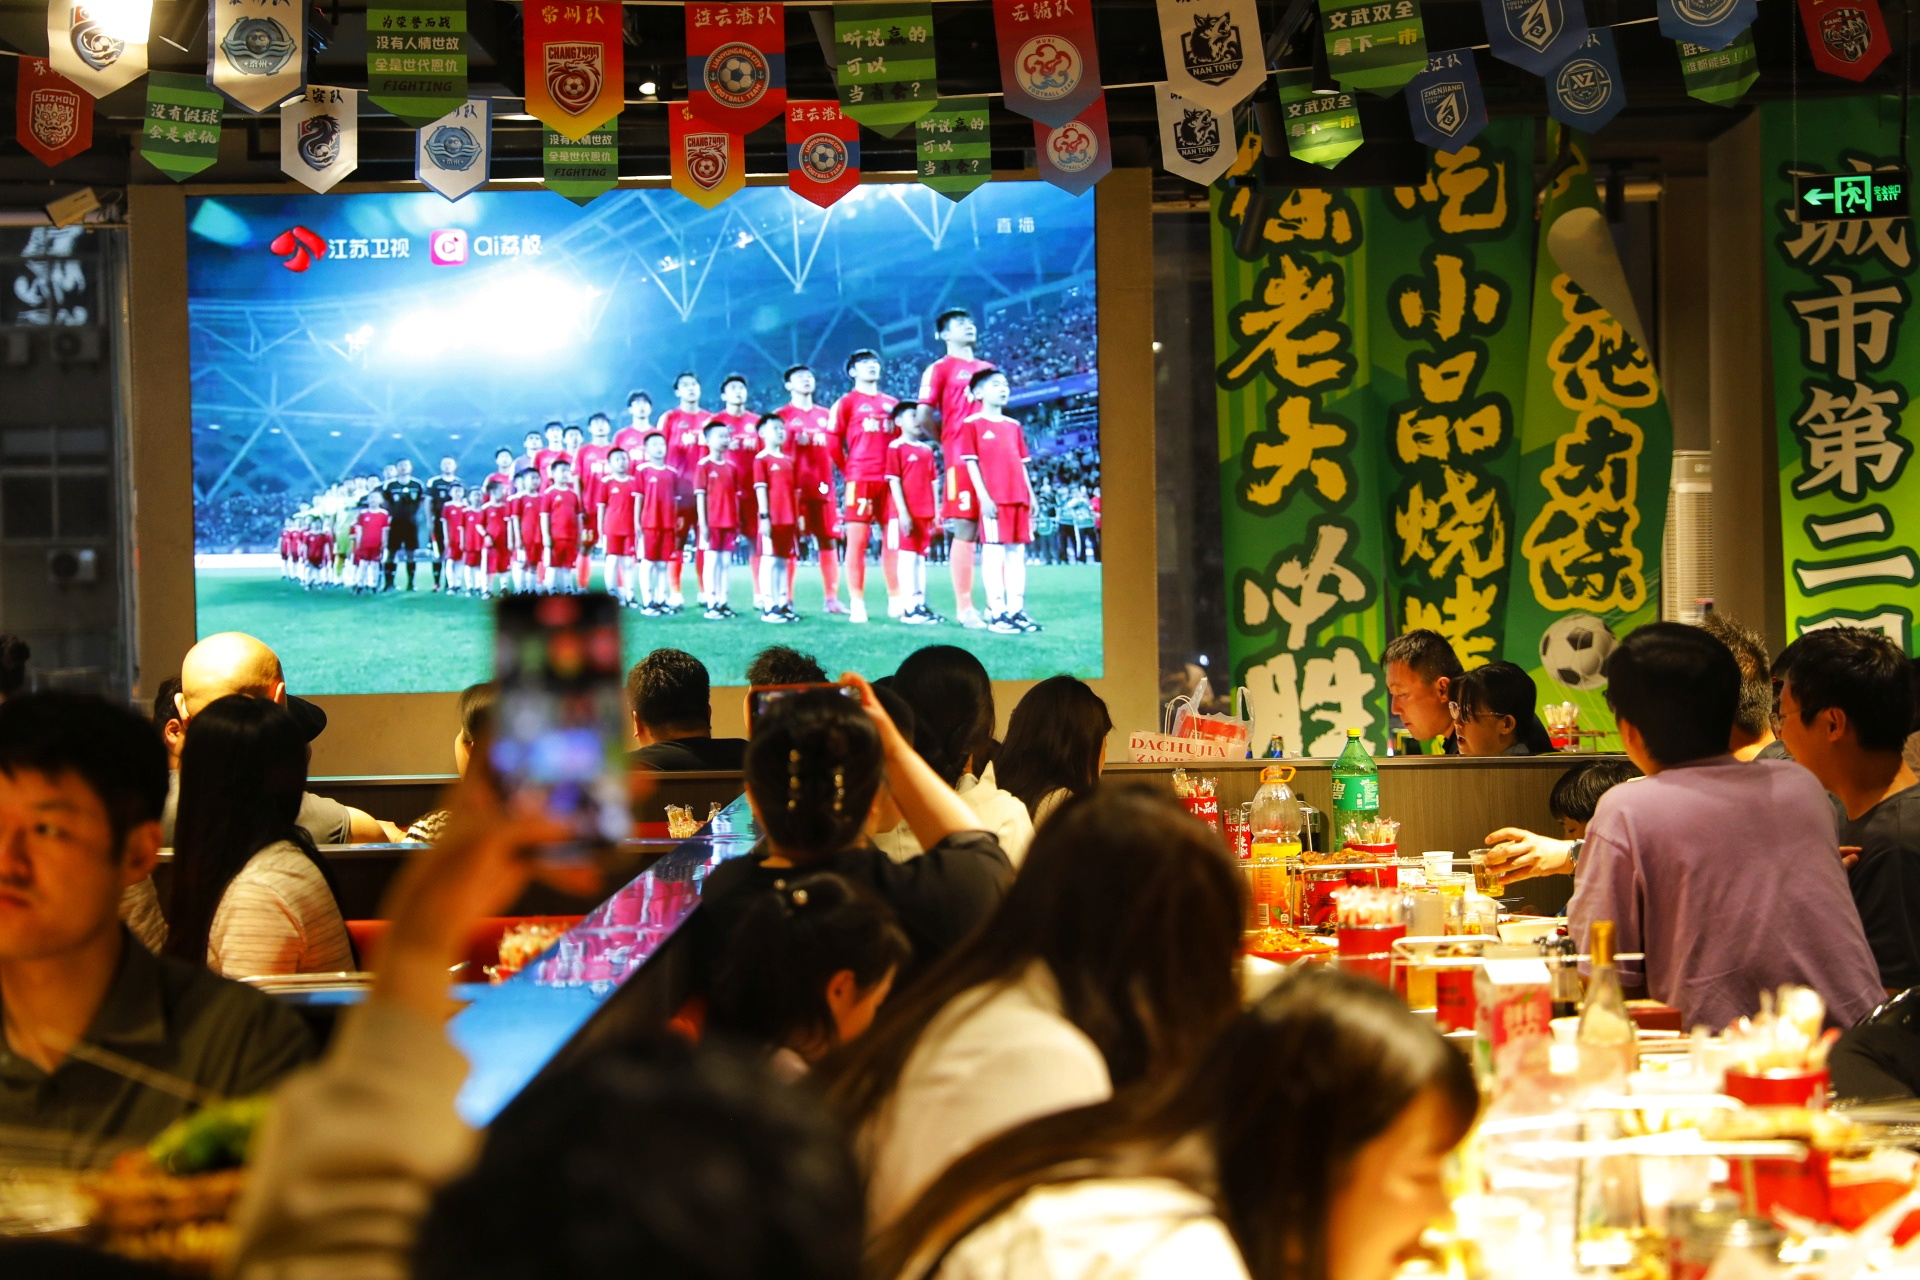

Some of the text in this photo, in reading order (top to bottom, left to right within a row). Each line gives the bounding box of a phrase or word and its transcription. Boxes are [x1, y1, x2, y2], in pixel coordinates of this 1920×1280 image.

[542, 5, 604, 25] 常州队
[694, 6, 776, 28] 连云港队
[1012, 0, 1074, 21] 无锡队
[1329, 0, 1414, 30] 文武双全
[383, 15, 451, 29] 为荣誉而战
[376, 35, 460, 51] 没有人情世故
[1333, 28, 1417, 56] 拿下一市
[374, 58, 458, 72] 全是世代恩仇
[750, 54, 763, 68] CITY
[846, 56, 887, 76] 可以
[1192, 62, 1239, 76] NAN TONG
[383, 80, 453, 92] FIGHTING
[712, 84, 762, 103] FOOTBALL TEAM
[1028, 79, 1075, 97] FOOTBALL TEAM
[1424, 84, 1462, 98] ZHENJIANG
[35, 93, 76, 106] SUZHOU
[300, 88, 344, 104] 安队
[151, 103, 220, 125] 没有假球
[1288, 94, 1352, 119] 文武双全
[149, 125, 217, 144] 全是世仇
[1291, 115, 1355, 138] 拿下一市
[923, 139, 954, 154] 可以
[1181, 145, 1216, 156] NAN TONG
[548, 151, 611, 162] 全是世代恩仇
[554, 168, 607, 177] FIGHTING
[830, 164, 842, 177] TEAM
[1873, 184, 1902, 195] 安全出口
[1876, 193, 1899, 202] EXIT
[997, 217, 1035, 234] 直播
[328, 238, 411, 260] 江苏卫视
[473, 234, 543, 258] ai荔枝
[1784, 158, 1914, 652] 城市第二
[1130, 737, 1226, 758] DACHUJIA
